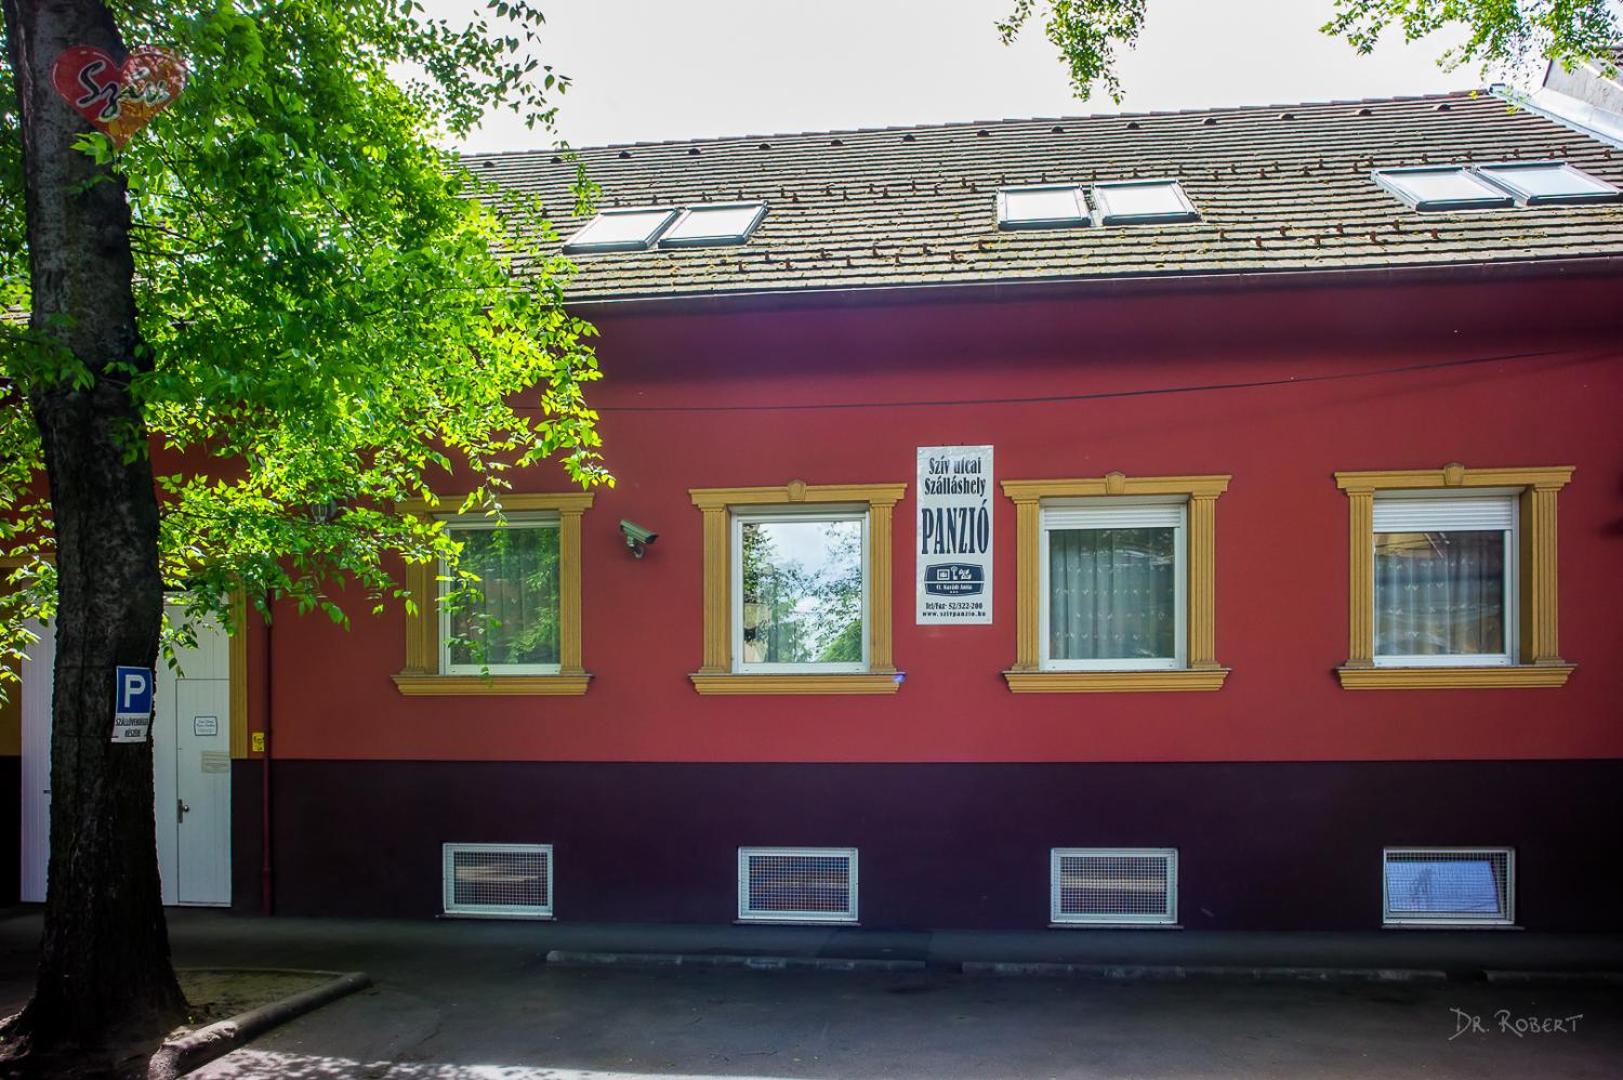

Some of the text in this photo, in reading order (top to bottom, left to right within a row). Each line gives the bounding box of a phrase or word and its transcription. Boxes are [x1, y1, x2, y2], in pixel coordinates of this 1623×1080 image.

[928, 455, 982, 475] Szív utcai
[924, 476, 987, 498] Szálláshely
[921, 499, 990, 555] PANZIÓ
[124, 674, 146, 708] P
